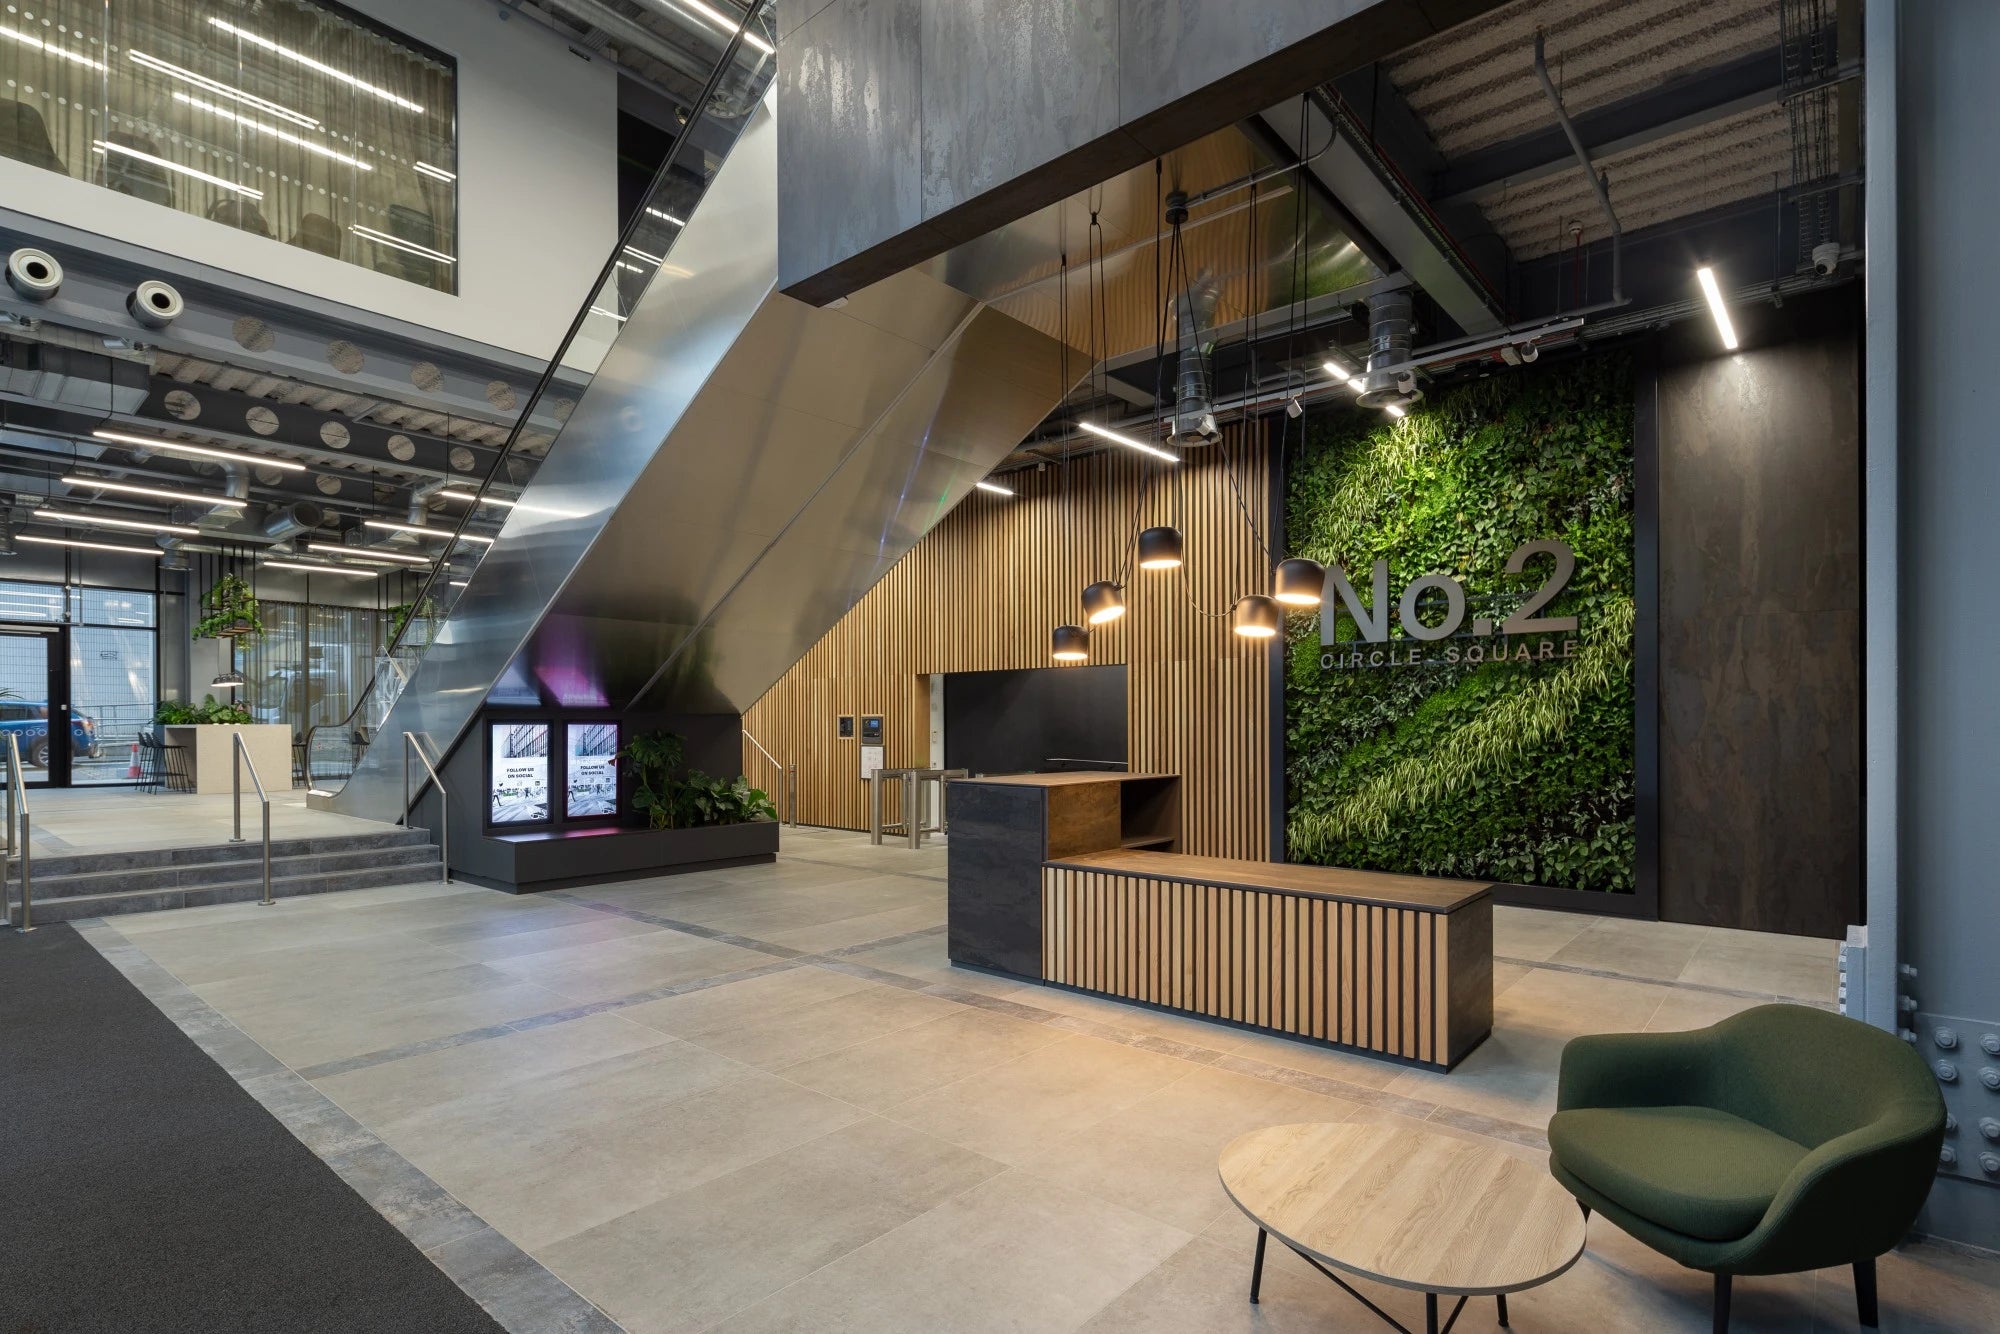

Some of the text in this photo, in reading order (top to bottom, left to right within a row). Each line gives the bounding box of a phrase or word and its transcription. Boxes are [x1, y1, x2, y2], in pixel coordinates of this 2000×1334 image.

[1320, 539, 1578, 646] No.2
[1320, 640, 1579, 670] CIRCLE SQUARE
